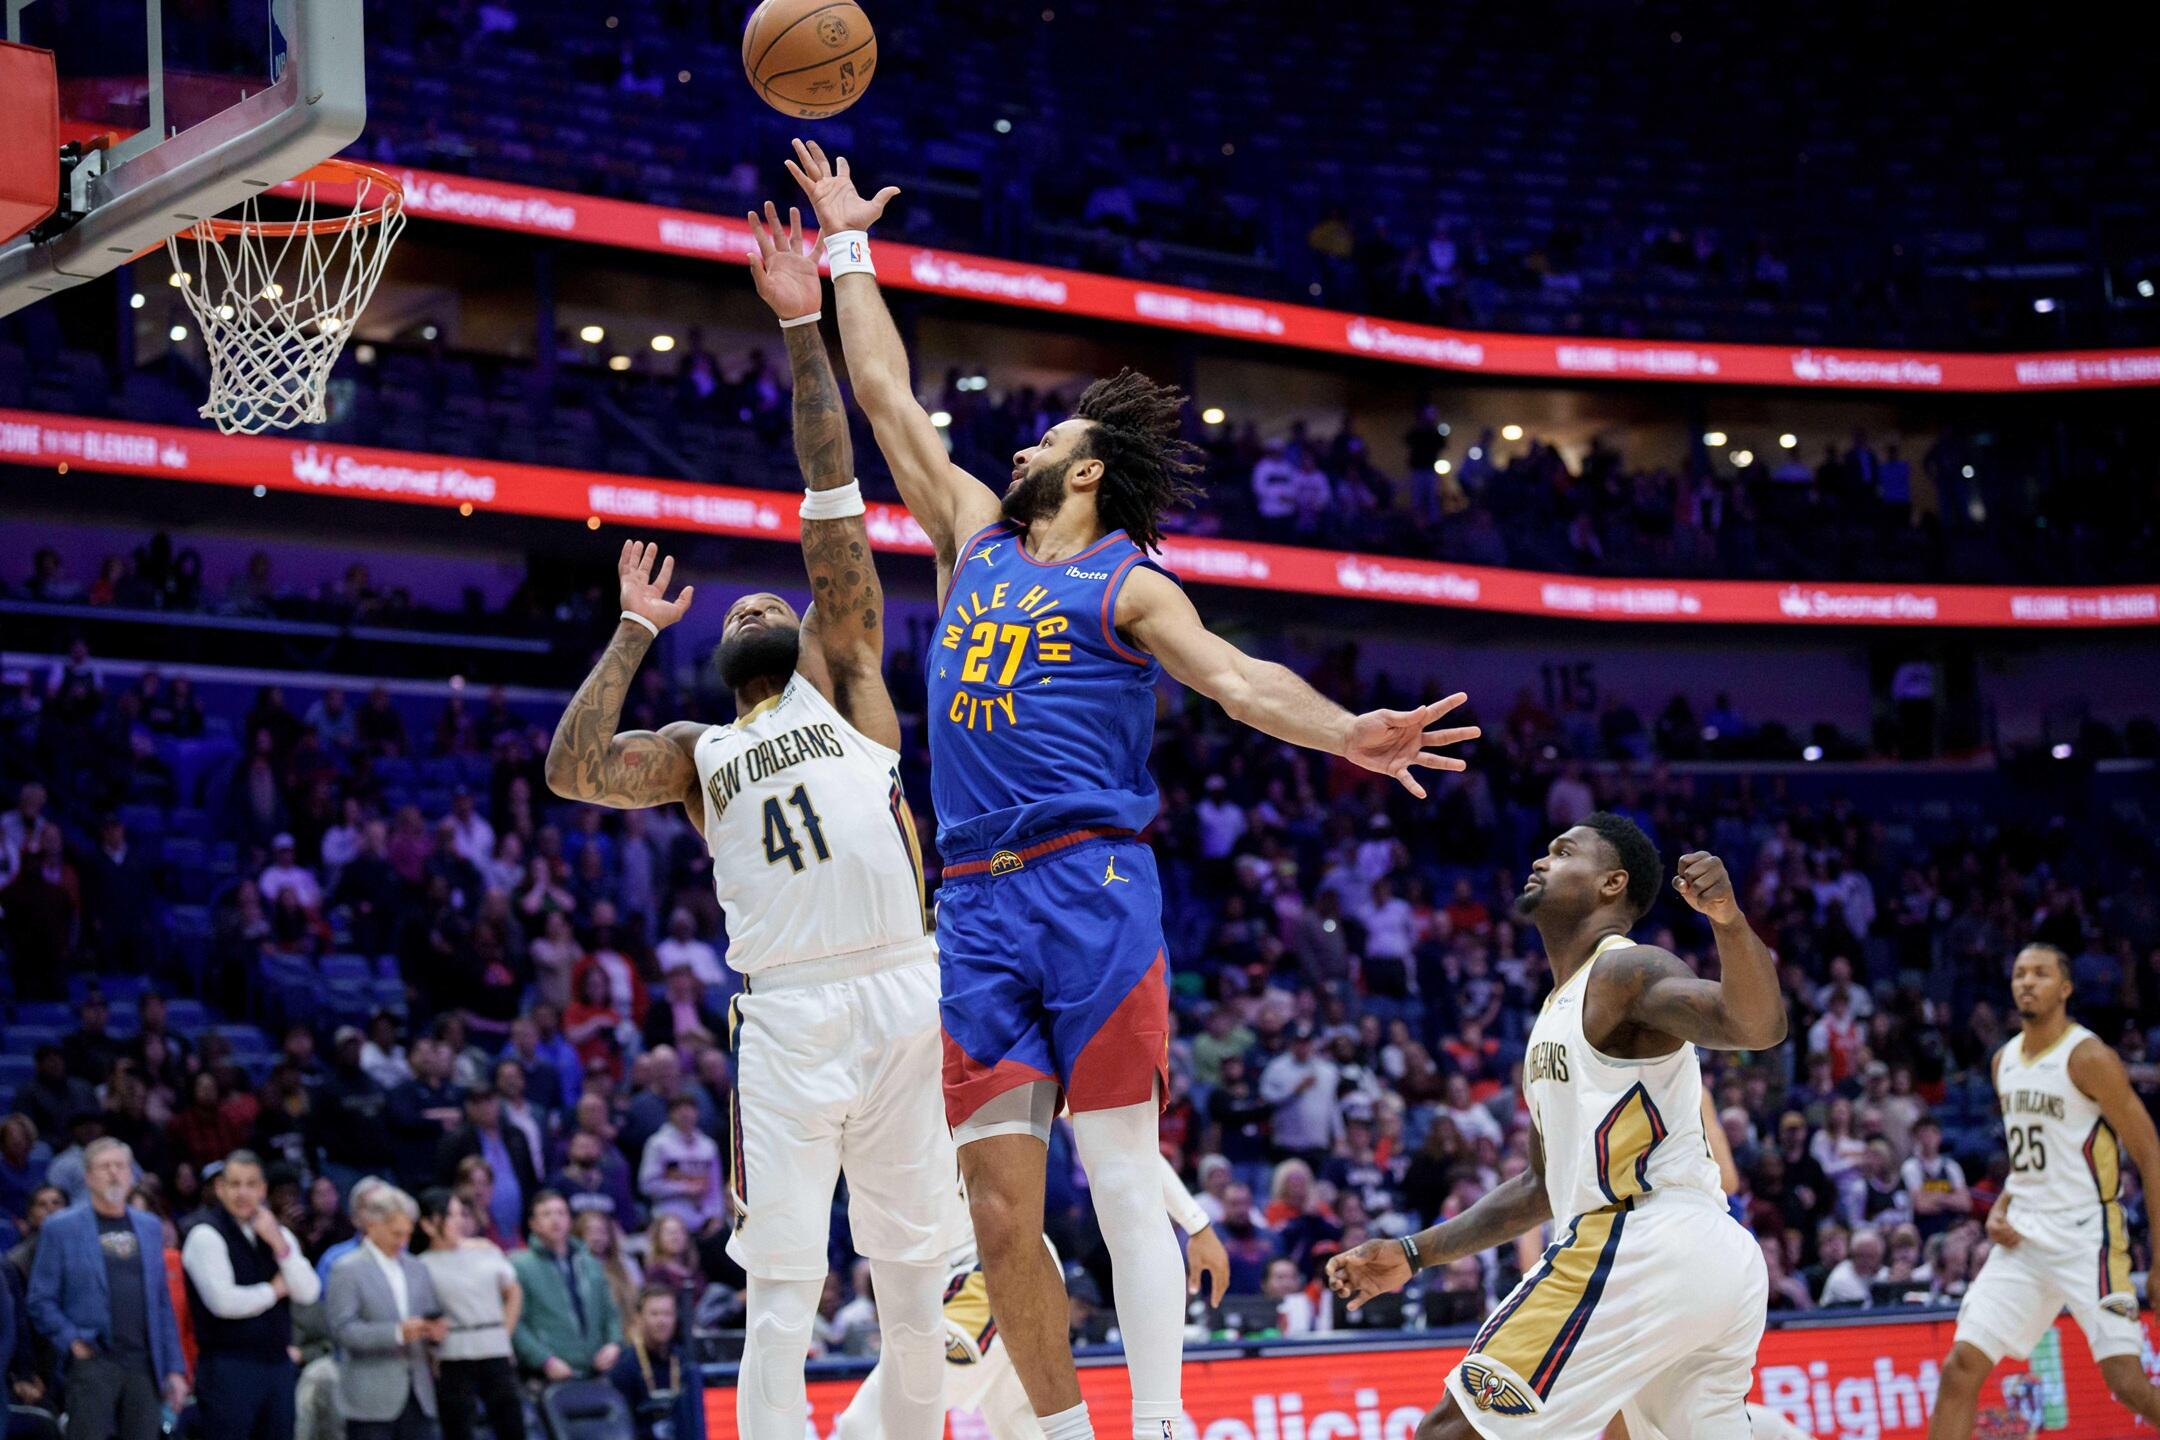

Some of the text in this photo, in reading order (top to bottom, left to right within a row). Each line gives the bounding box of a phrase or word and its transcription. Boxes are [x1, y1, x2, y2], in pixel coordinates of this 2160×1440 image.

[1065, 565, 1108, 581] ibotta
[941, 581, 1073, 663] MILE HIGH
[960, 620, 1032, 687] 27
[949, 690, 1018, 732] CITY
[707, 723, 844, 822] NEW ORLEANS
[762, 782, 833, 876] 41
[2009, 1125, 2046, 1172] 25
